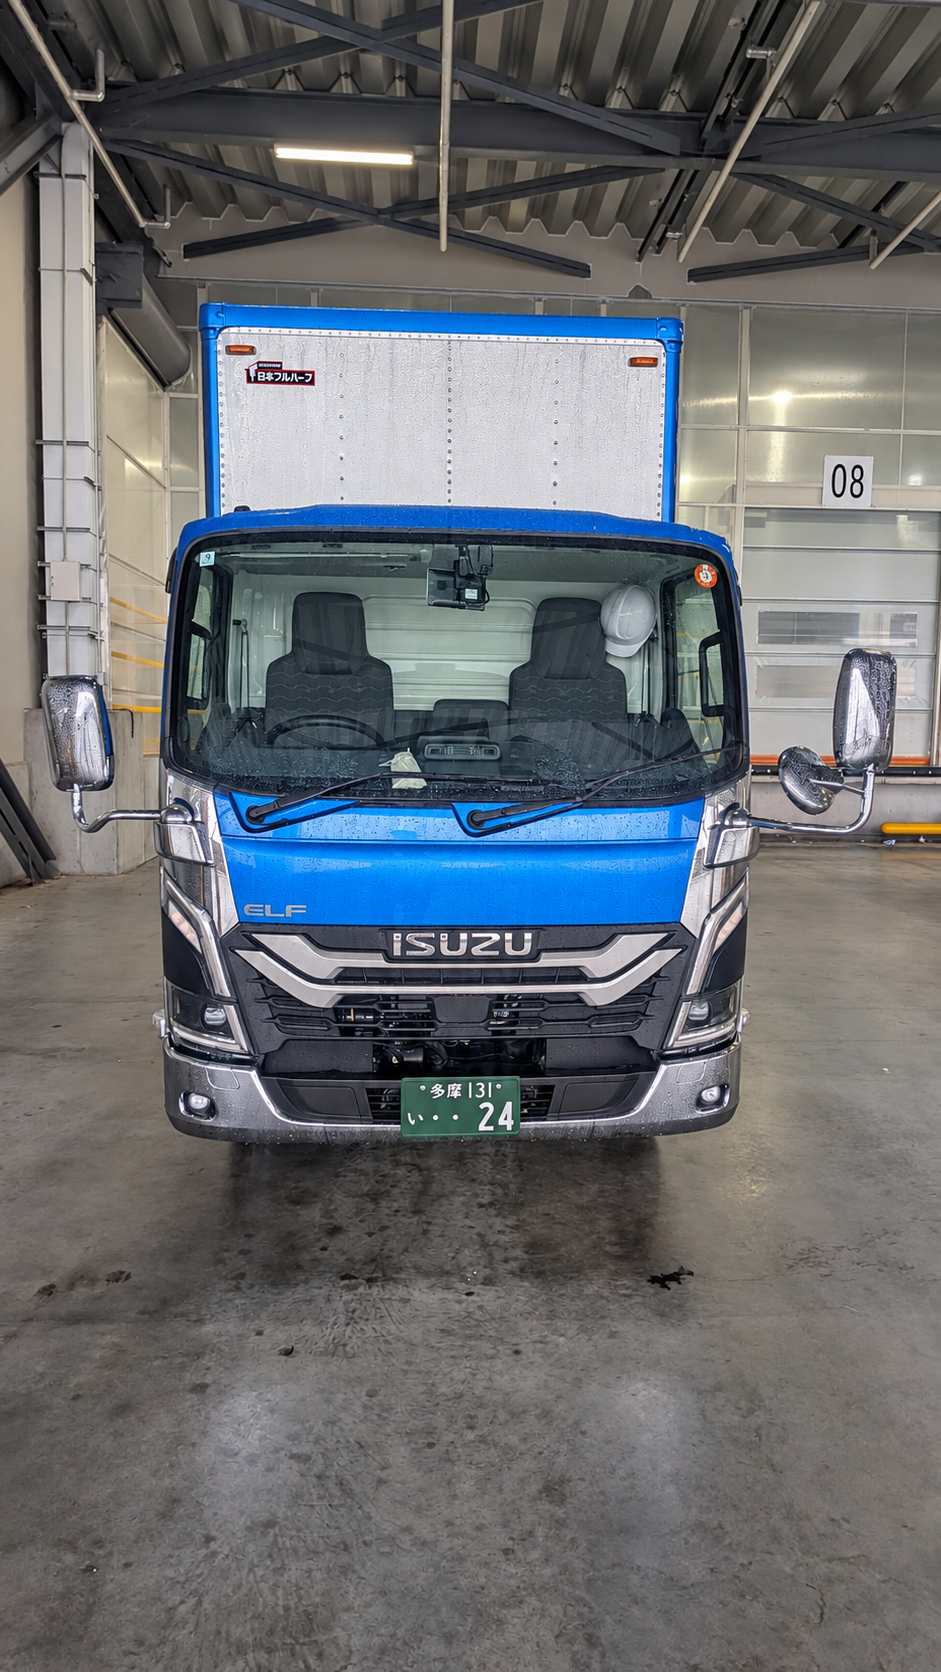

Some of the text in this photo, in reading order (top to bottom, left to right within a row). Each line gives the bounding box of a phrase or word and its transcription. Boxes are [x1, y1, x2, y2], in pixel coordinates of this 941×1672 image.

[257, 371, 313, 383] 日本フルハーフ
[831, 463, 864, 499] 08
[243, 904, 307, 917] ELF
[393, 932, 532, 956] ISUZU
[430, 1081, 492, 1099] 多摩 131
[407, 1112, 424, 1126] い
[478, 1101, 515, 1131] 24
